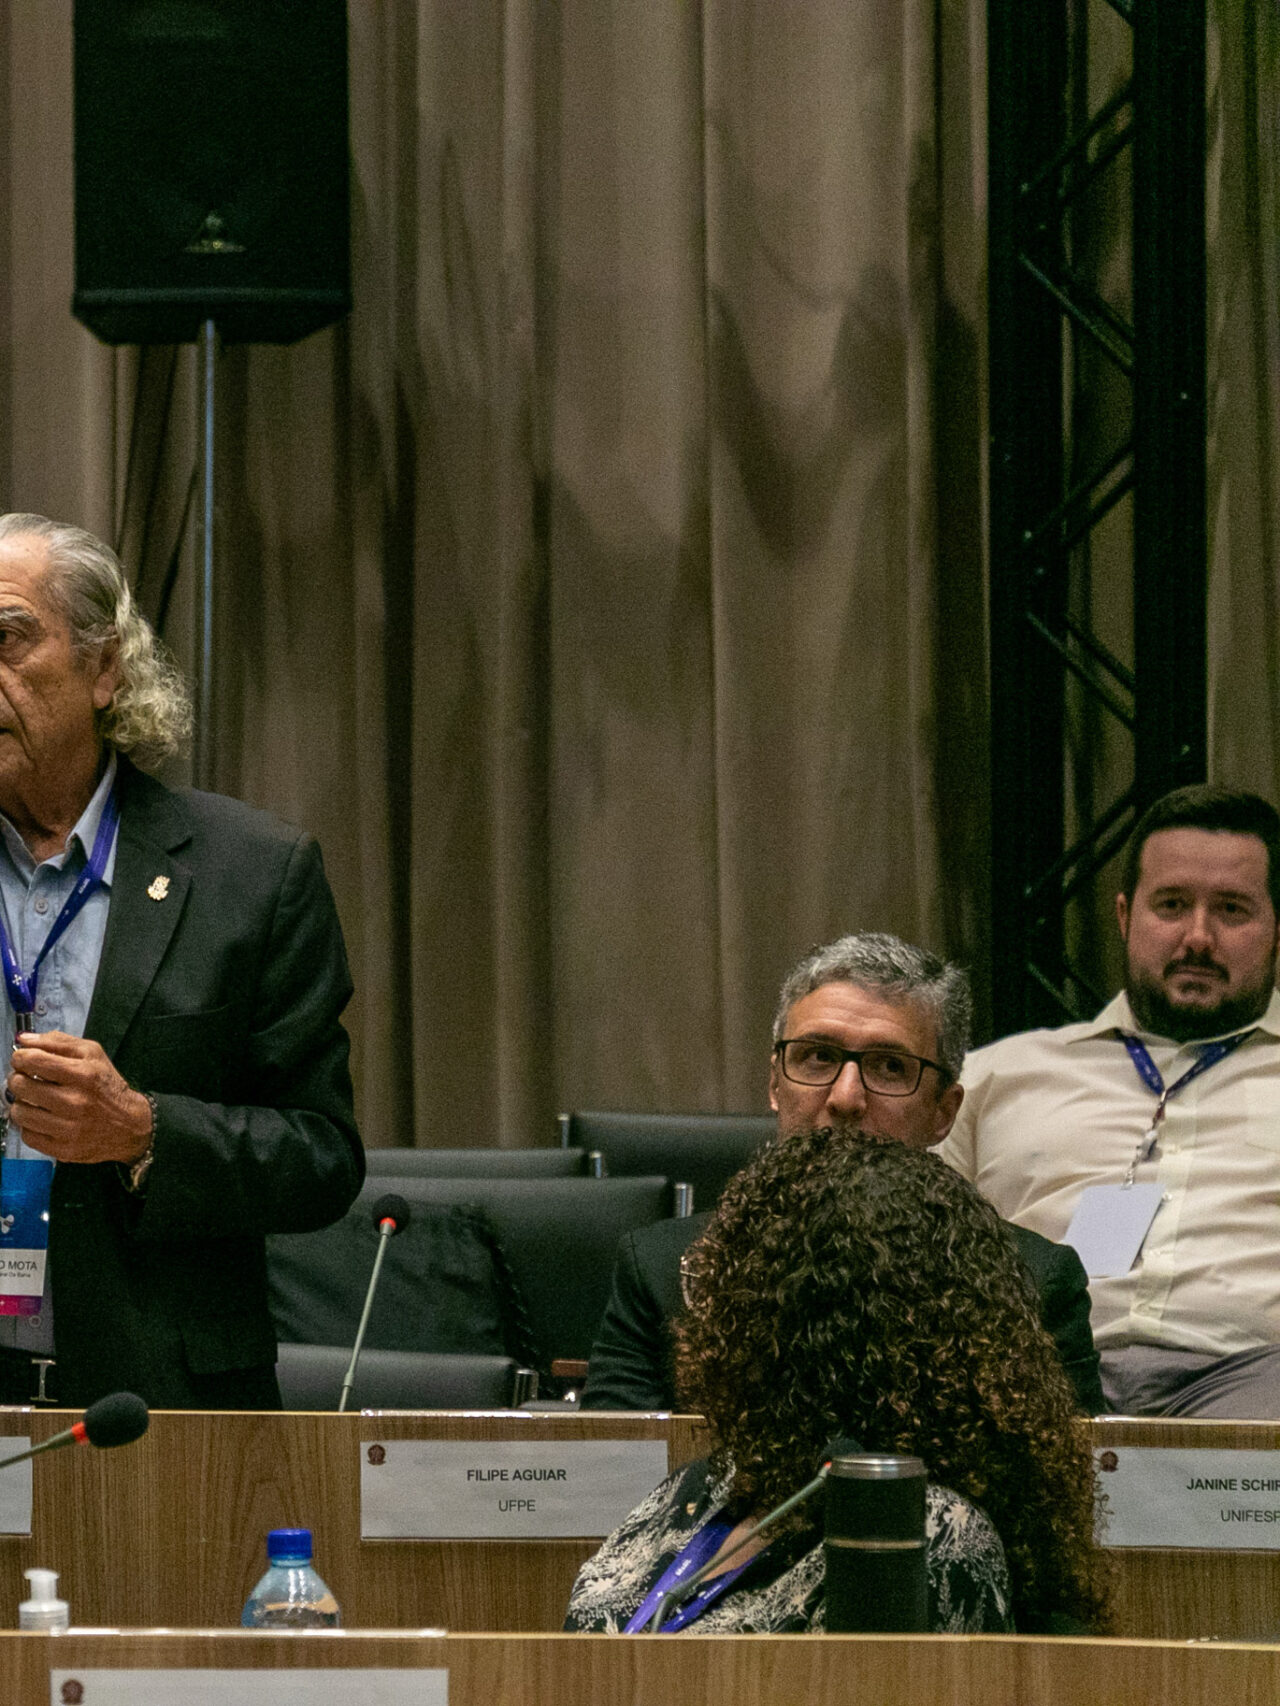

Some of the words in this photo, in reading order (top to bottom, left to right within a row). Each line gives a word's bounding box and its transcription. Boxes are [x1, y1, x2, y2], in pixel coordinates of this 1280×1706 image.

[8, 1260, 38, 1271] MOTA
[466, 1469, 509, 1481] FILIPE
[512, 1469, 568, 1481] AGUIAR
[1186, 1478, 1238, 1491] JANINE
[498, 1499, 537, 1512] UFPE
